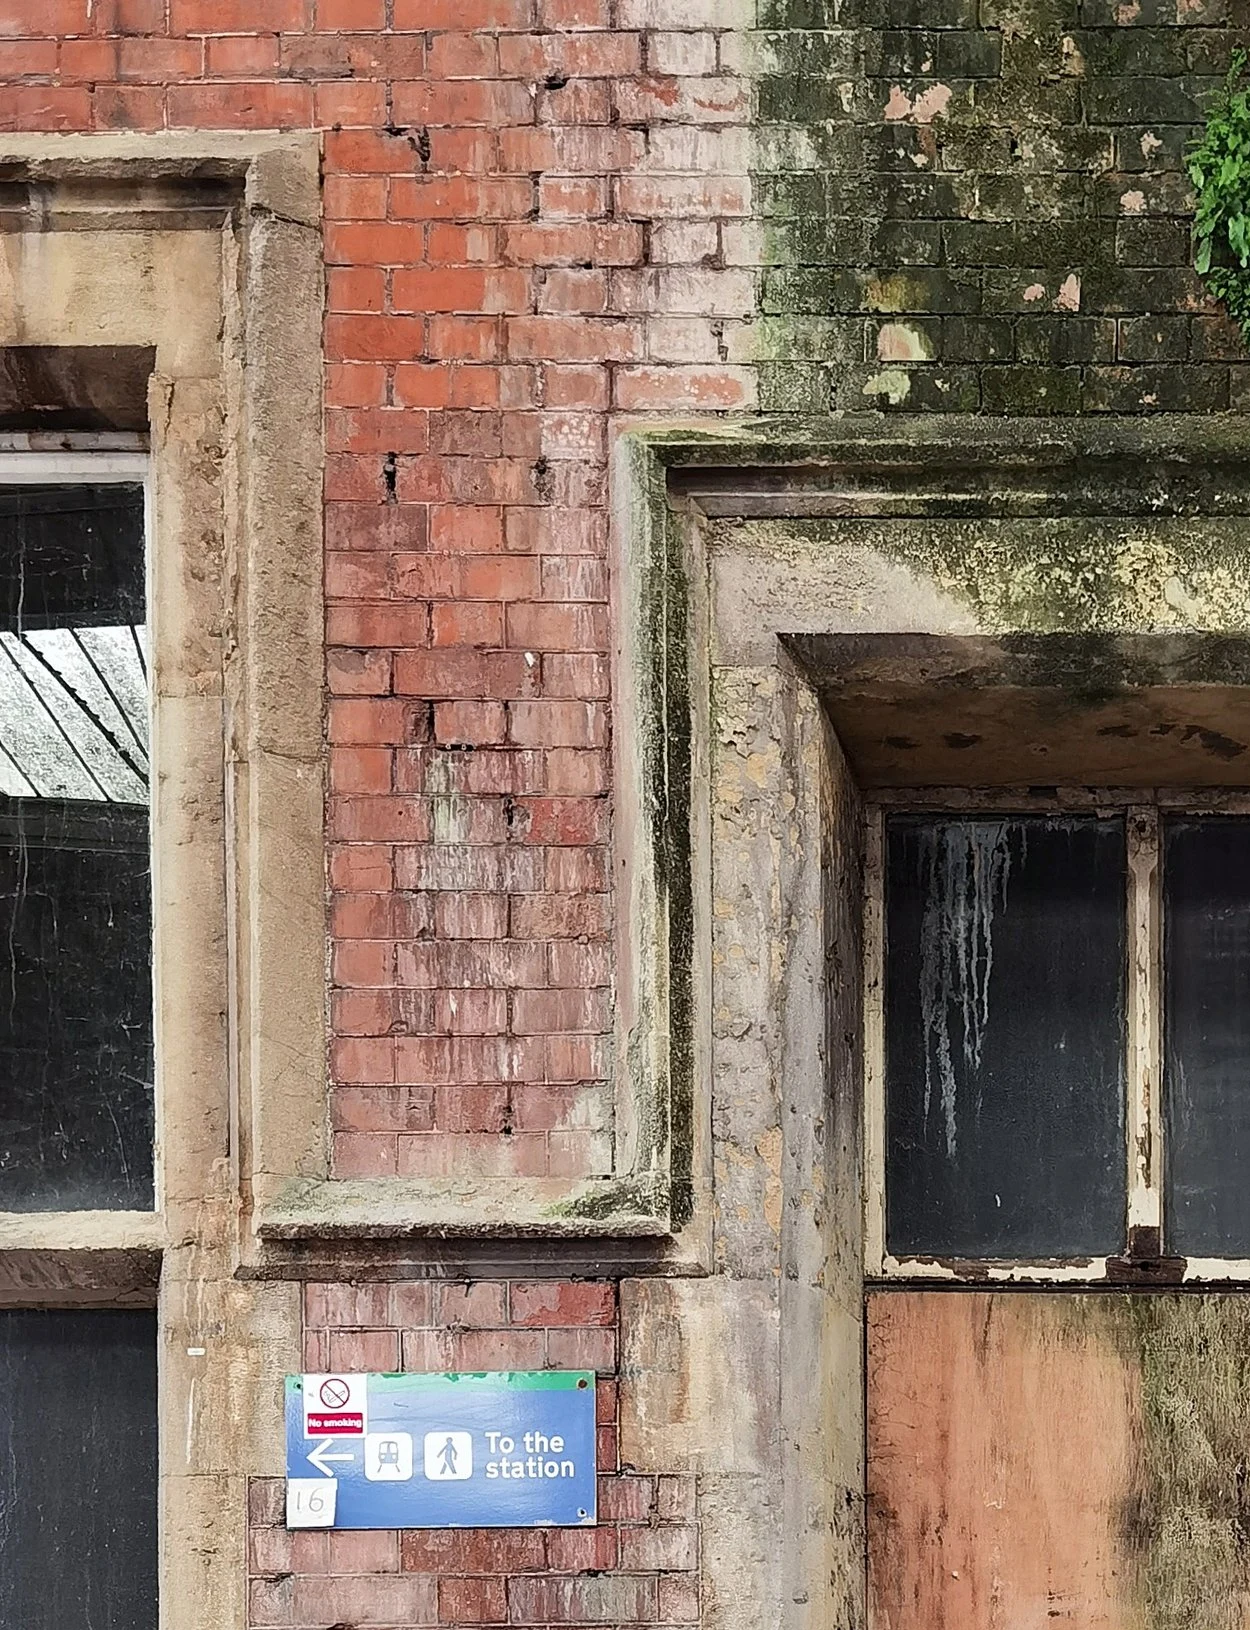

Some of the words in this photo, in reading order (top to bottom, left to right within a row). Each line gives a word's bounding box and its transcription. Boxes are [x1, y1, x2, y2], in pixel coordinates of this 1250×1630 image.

[308, 1418, 322, 1427] No
[324, 1418, 361, 1428] smoking
[485, 1432, 514, 1453] To
[523, 1432, 564, 1453] the
[486, 1457, 574, 1478] station
[295, 1488, 324, 1512] 16
